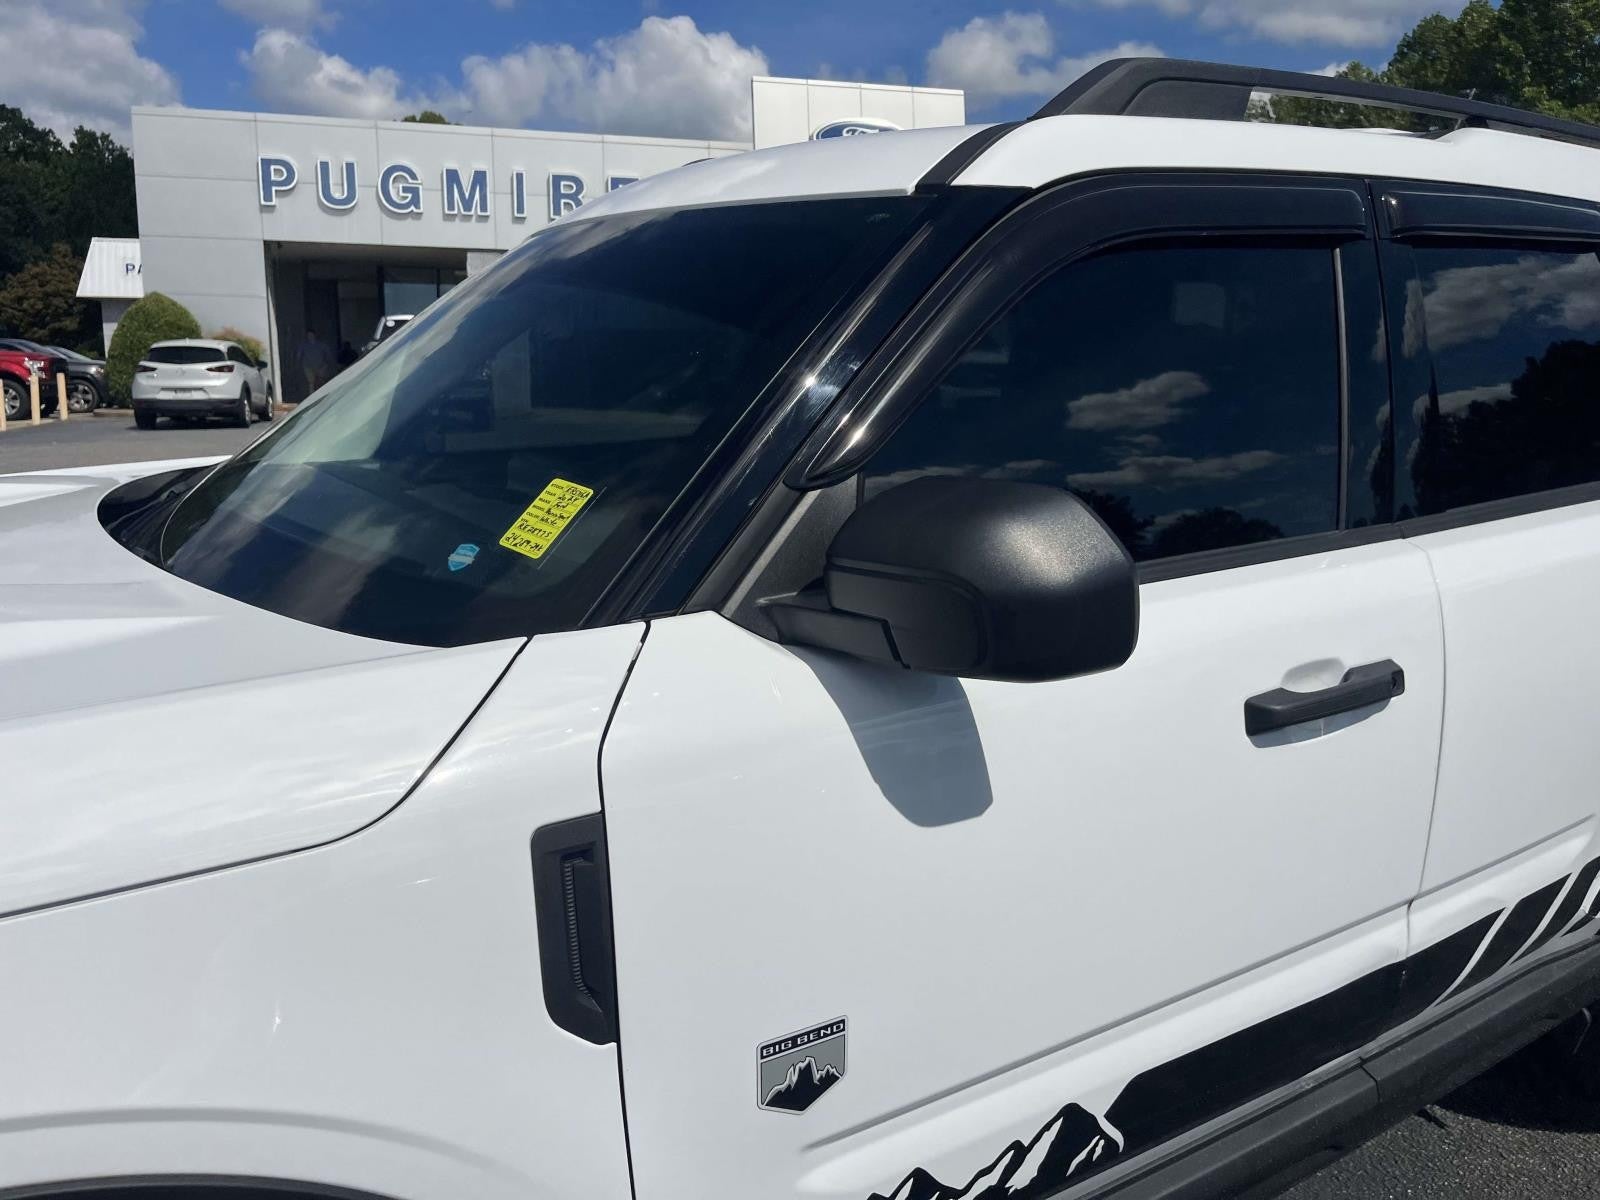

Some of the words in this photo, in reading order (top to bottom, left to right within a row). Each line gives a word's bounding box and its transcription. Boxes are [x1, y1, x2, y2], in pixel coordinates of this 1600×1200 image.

[257, 155, 640, 220] PUGMIR
[762, 1040, 792, 1057] BIG
[797, 1022, 844, 1045] BEND
